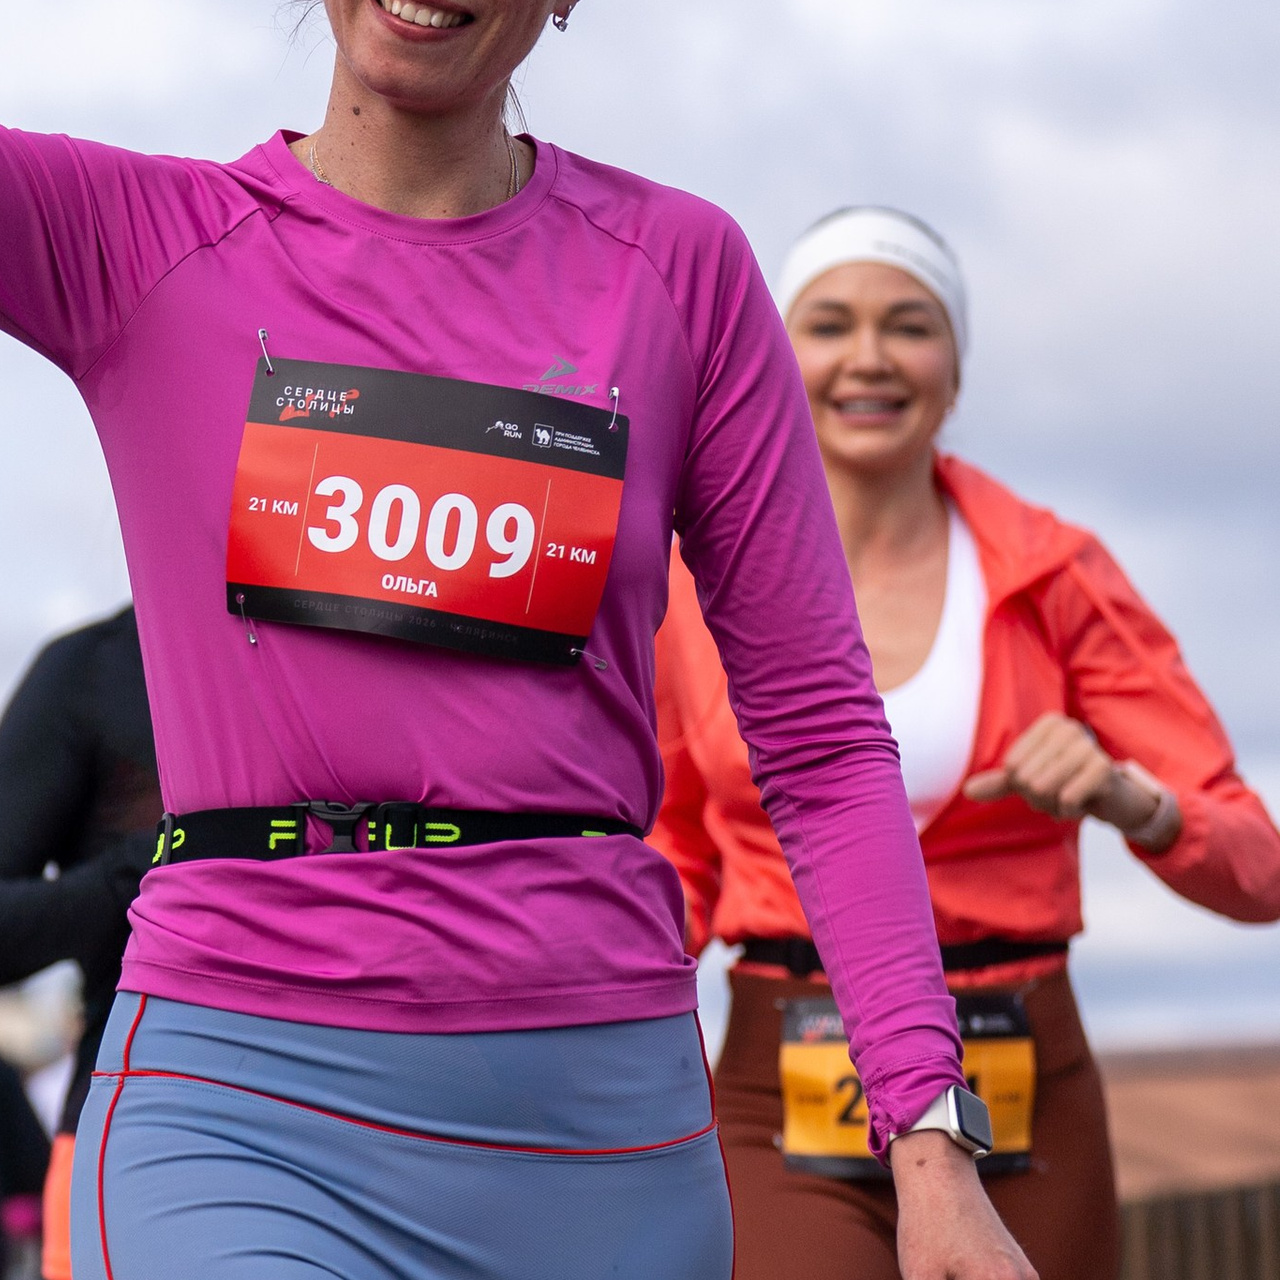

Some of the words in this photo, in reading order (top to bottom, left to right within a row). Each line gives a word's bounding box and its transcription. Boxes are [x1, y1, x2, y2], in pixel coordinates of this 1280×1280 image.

[283, 385, 348, 402] СЕРДЦЕ
[521, 383, 599, 396] DEMIX
[275, 397, 355, 415] СТОЛИЦЫ
[503, 430, 522, 439] RUN
[504, 422, 519, 431] GO
[248, 496, 267, 512] 21
[272, 499, 299, 516] КМ
[307, 475, 536, 579] 3009
[545, 542, 565, 559] 21
[570, 546, 597, 565] КМ
[381, 573, 439, 598] ОЛЬГА
